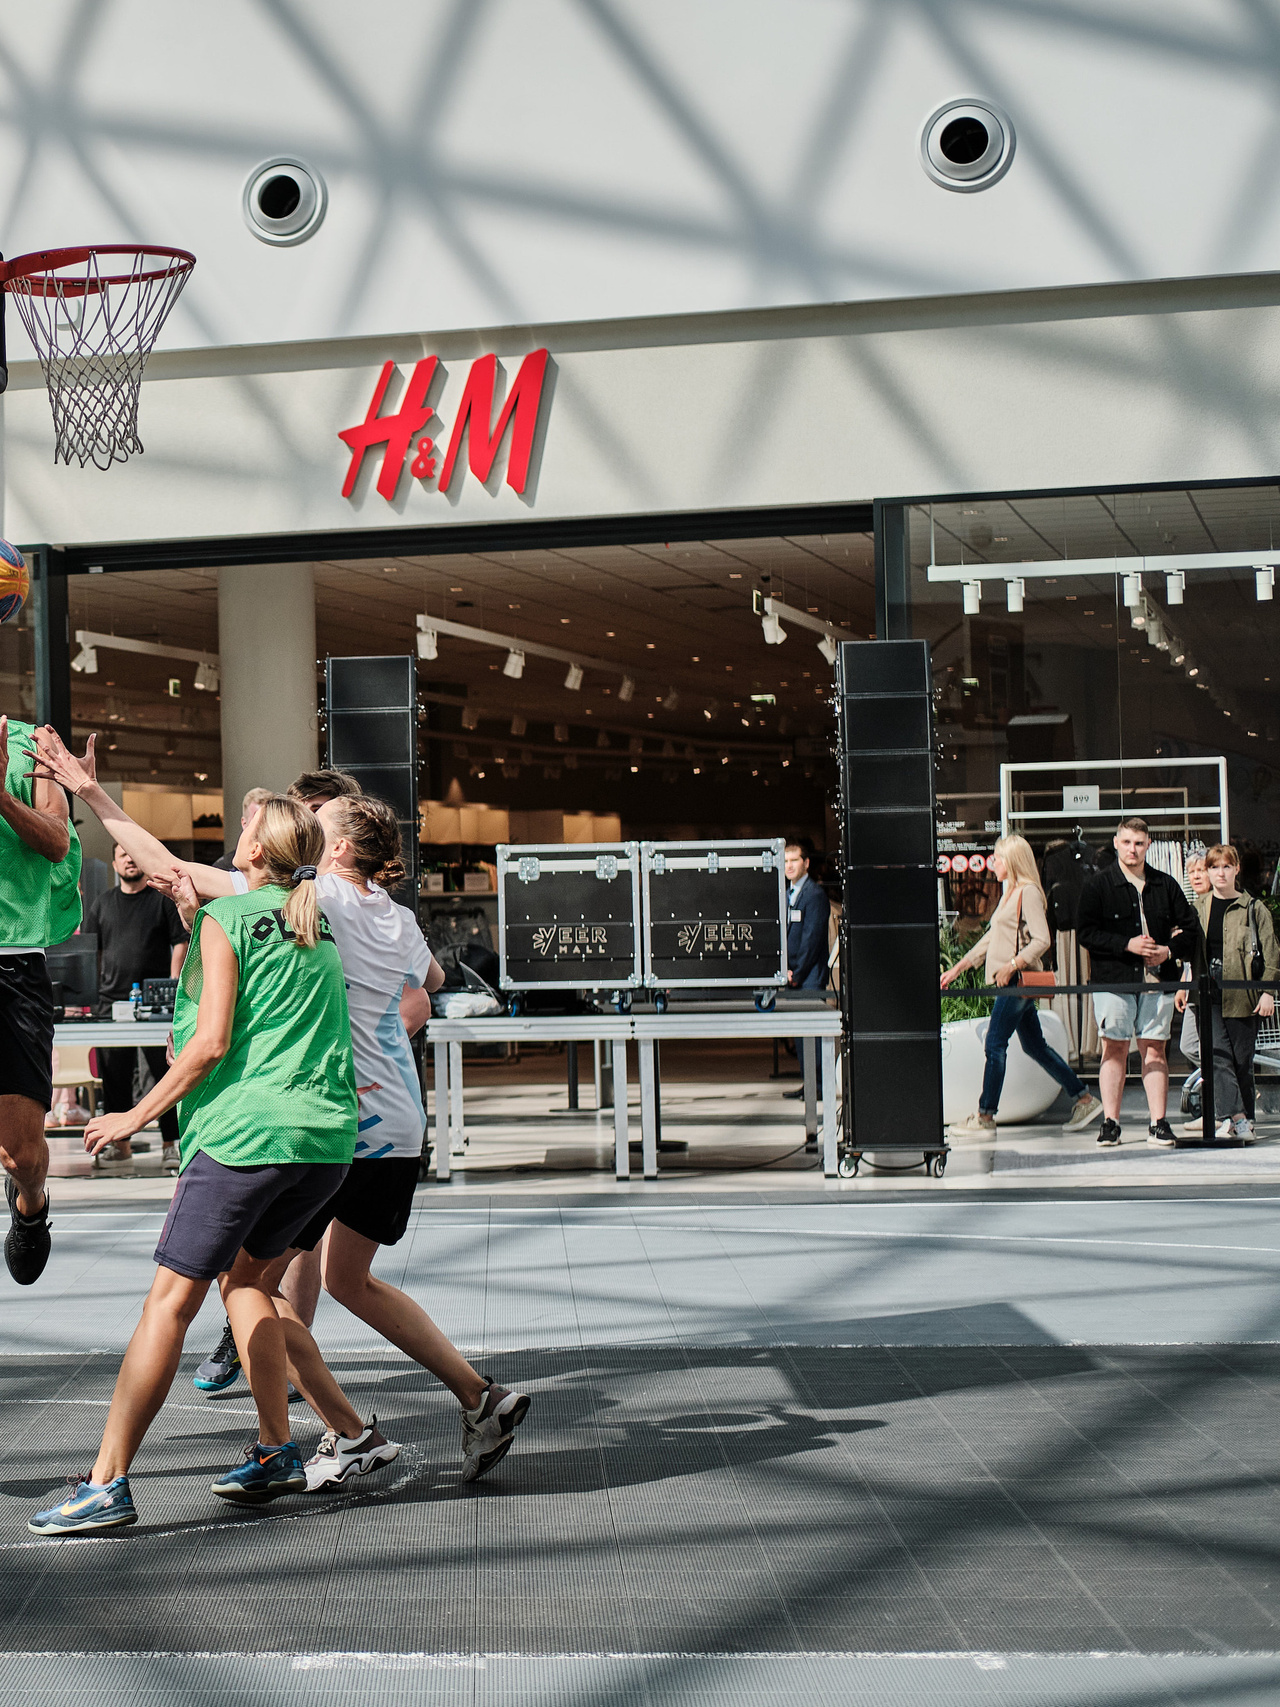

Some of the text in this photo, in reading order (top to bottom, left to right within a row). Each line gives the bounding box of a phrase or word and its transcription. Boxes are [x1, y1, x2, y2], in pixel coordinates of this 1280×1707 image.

[337, 348, 549, 501] H&M
[559, 945, 606, 954] MALL
[704, 942, 752, 952] MALL
